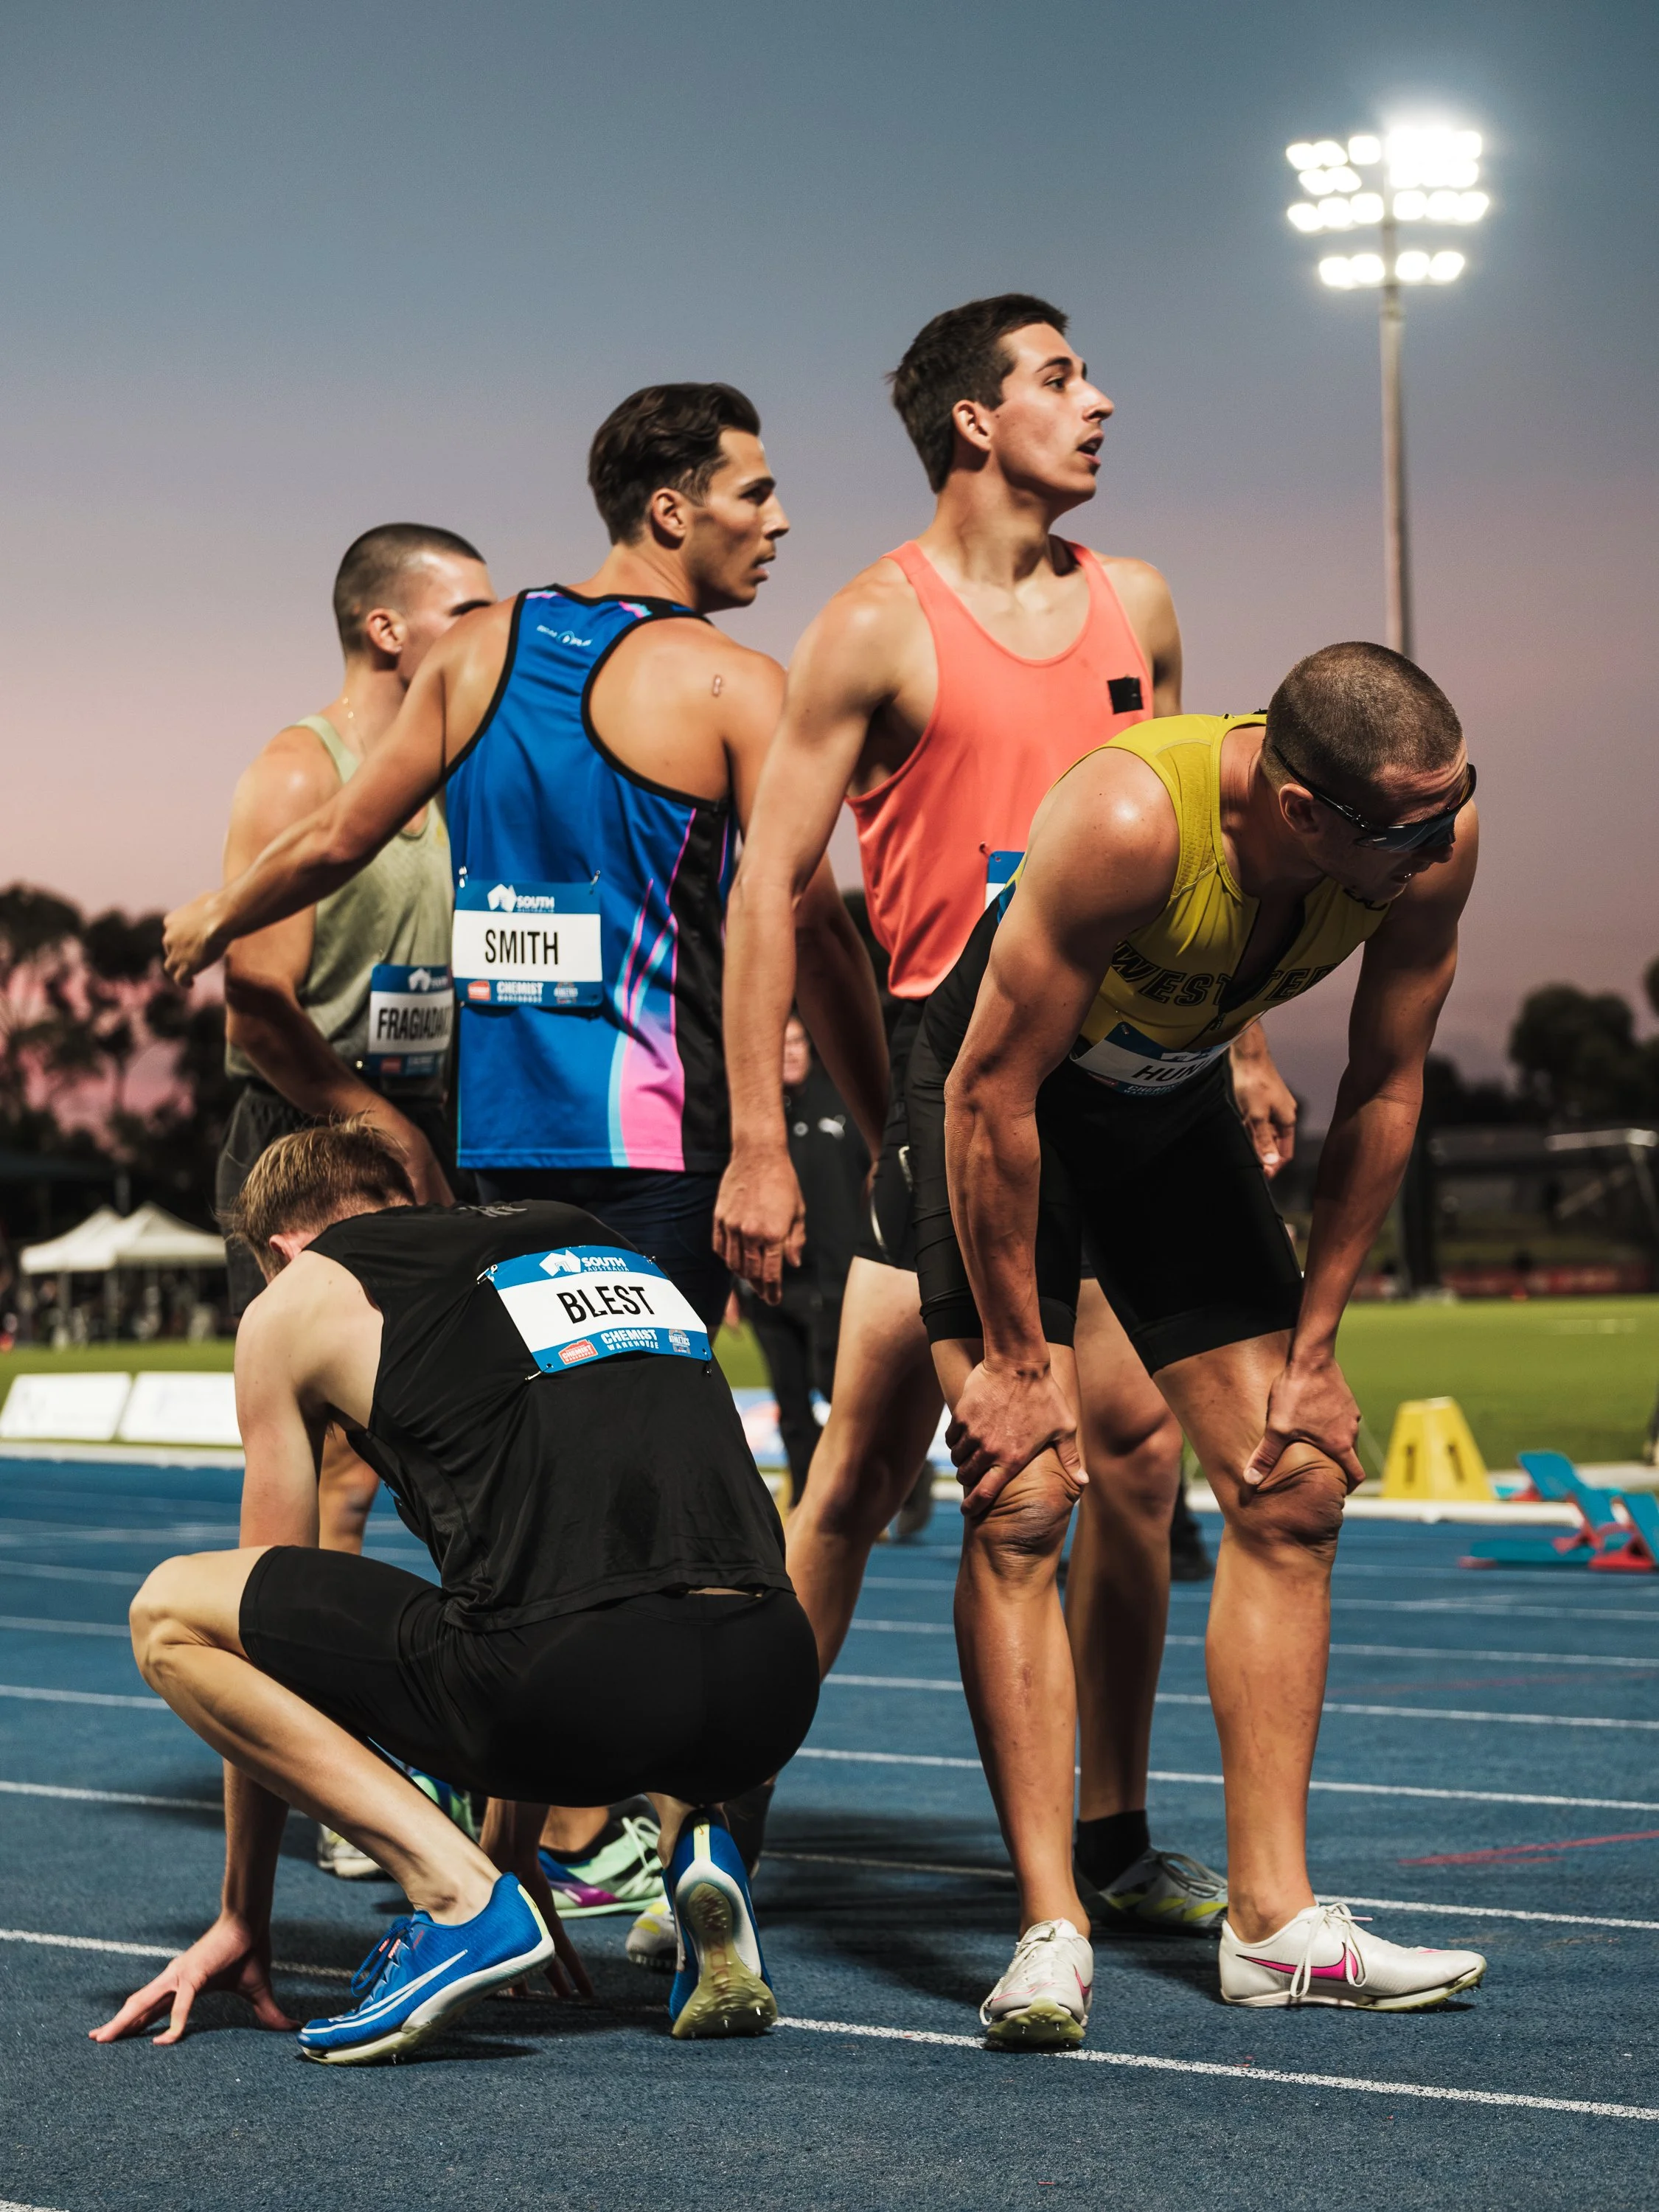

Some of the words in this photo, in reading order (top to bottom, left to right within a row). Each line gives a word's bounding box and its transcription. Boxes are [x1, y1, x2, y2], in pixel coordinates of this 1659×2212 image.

[516, 895, 555, 909] SOUTH
[484, 929, 559, 965] SMITH
[496, 981, 544, 995] CHEMIST
[581, 1256, 627, 1267] SOUTH
[557, 1285, 655, 1324] BLEST
[600, 1329, 658, 1344] CHEMIST
[561, 1345, 592, 1359] CHEMIST
[607, 1340, 659, 1351] WAREHOUSE
